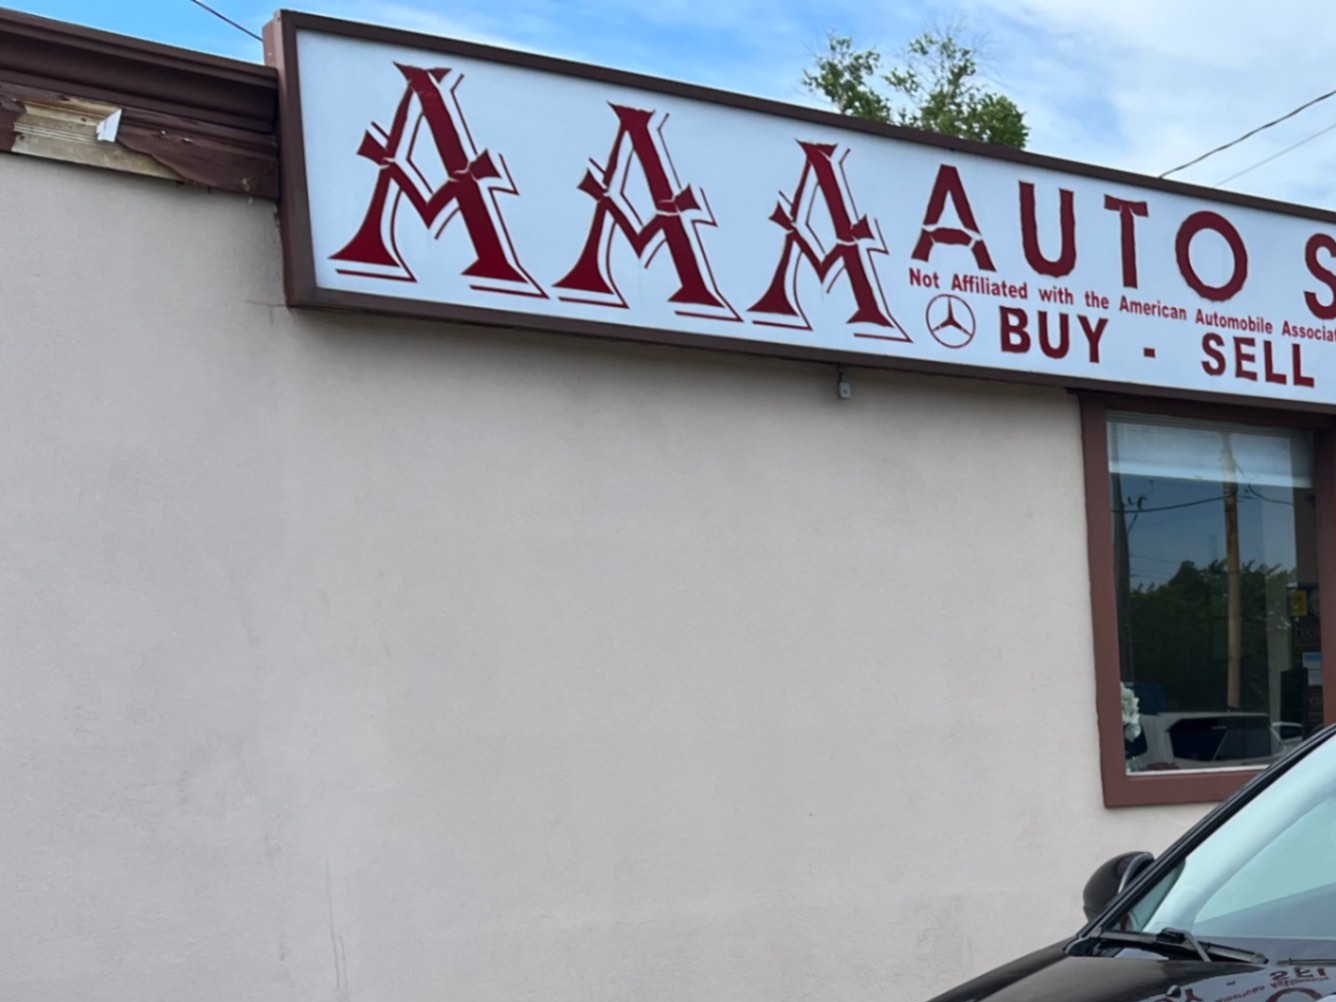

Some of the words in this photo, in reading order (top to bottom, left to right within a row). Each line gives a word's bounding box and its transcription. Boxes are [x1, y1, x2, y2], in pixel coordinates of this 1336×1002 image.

[911, 164, 1248, 302] AUTO
[909, 267, 940, 289] Not
[951, 273, 1028, 299] Affiliated
[1038, 286, 1074, 305] with
[1084, 290, 1110, 309] the
[1119, 295, 1187, 320] American
[1195, 309, 1273, 334] Automobile
[999, 305, 1109, 364] BUY
[1201, 332, 1315, 388] SELL
